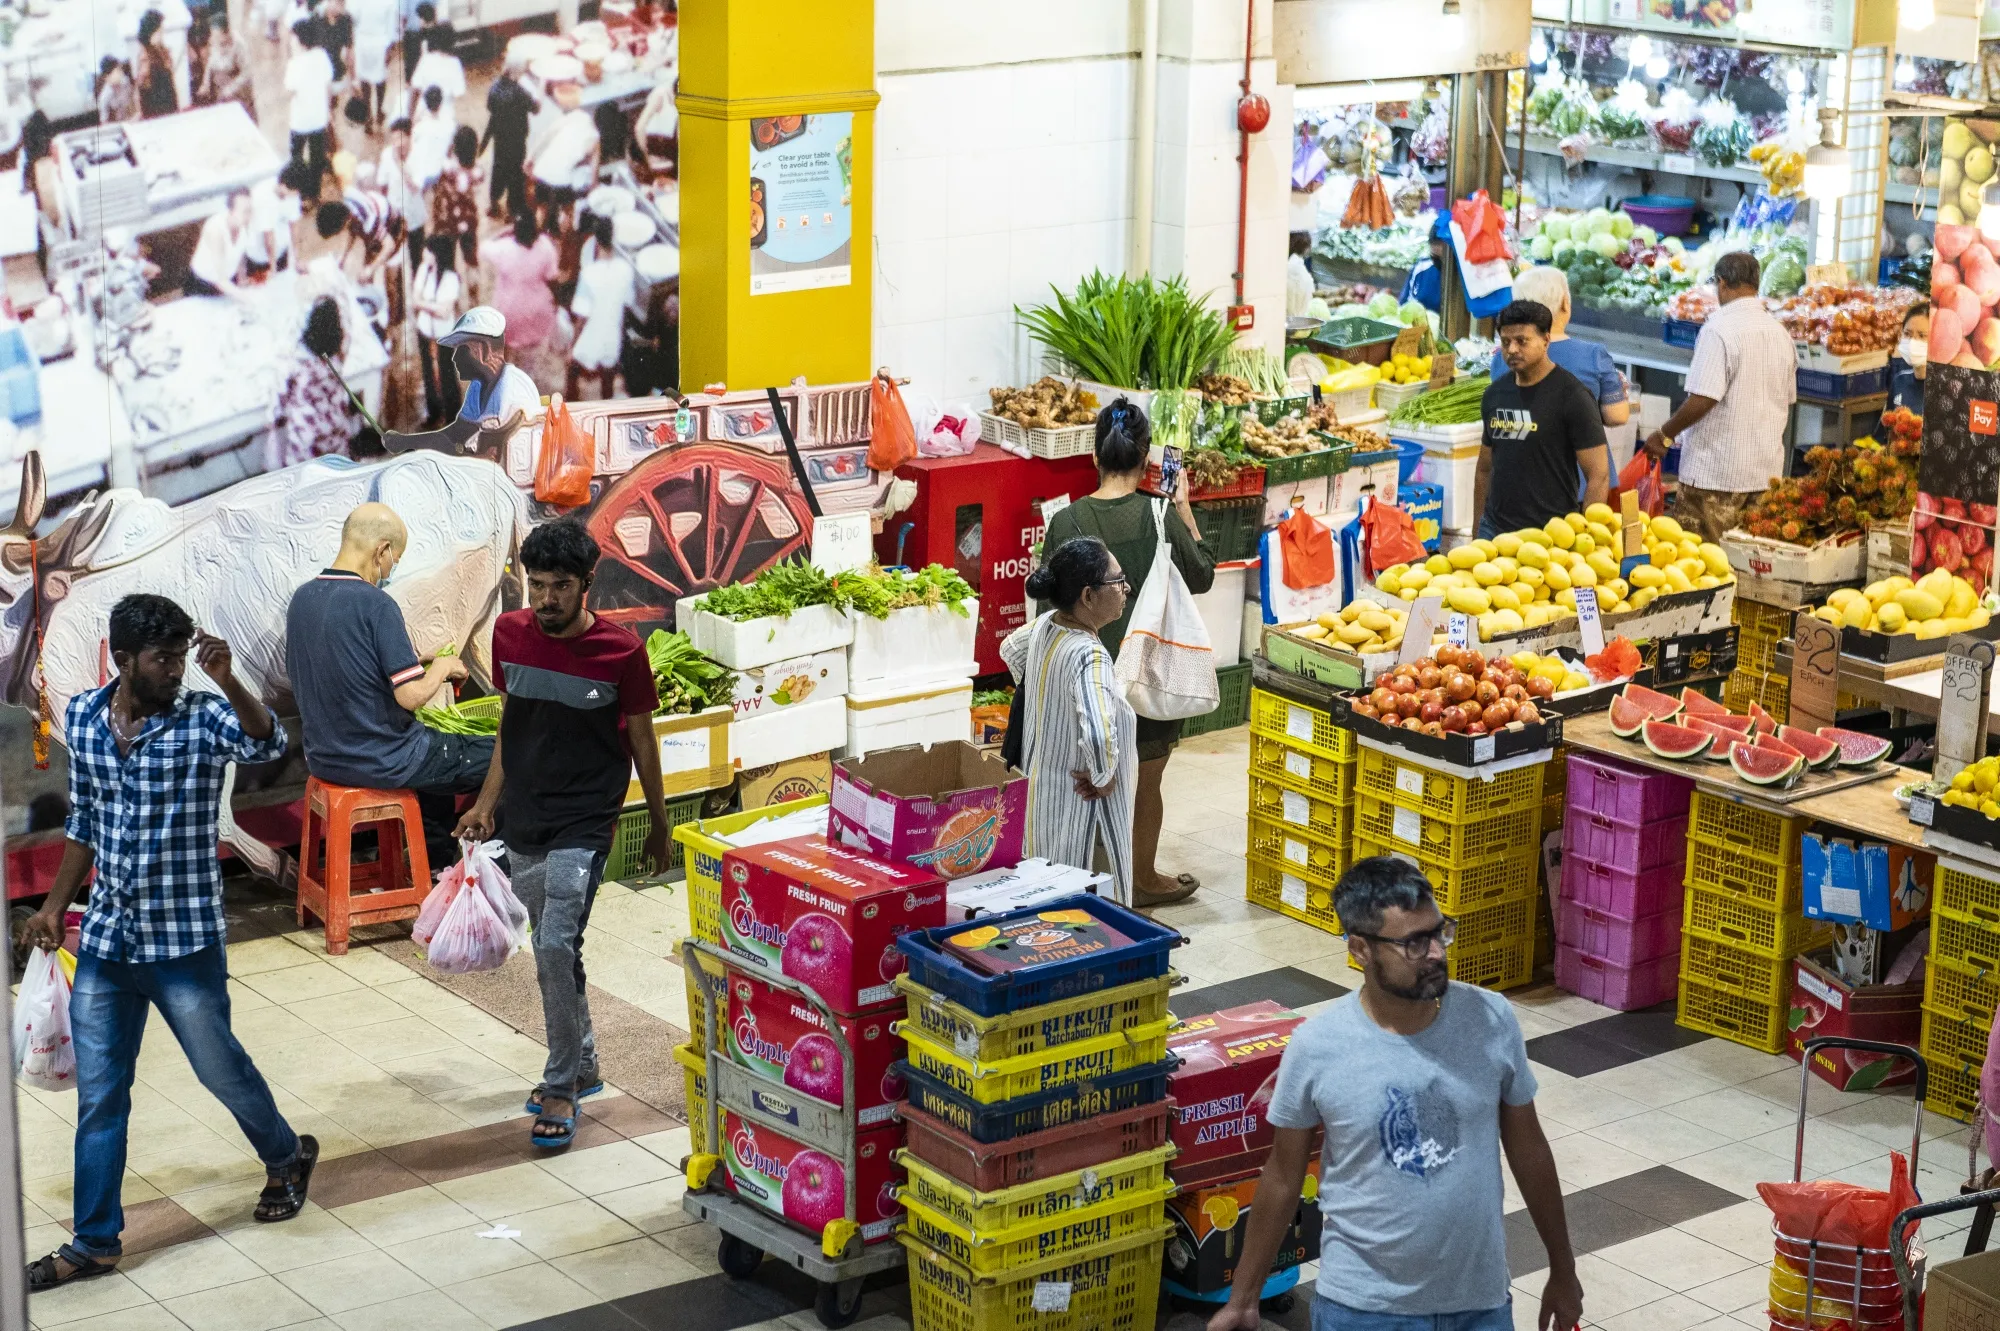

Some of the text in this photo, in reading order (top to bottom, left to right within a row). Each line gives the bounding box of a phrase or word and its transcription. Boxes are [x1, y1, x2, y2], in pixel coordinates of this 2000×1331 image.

[789, 161, 808, 169] avoid
[1974, 412, 1992, 428] Pay
[1021, 526, 1046, 547] FIR
[1000, 602, 1026, 614] OPERATI
[1946, 656, 1980, 676] OFFER
[1800, 669, 1825, 688] EACH
[906, 827, 927, 836] CITRUS
[763, 850, 867, 888] FRESH FRUIT
[805, 842, 909, 878] FRESH FRUIT
[787, 884, 847, 917] FRESH FRUIT
[738, 911, 788, 948] Apple
[1003, 923, 1055, 938] CITRUS
[1020, 940, 1105, 964] PREMIUM
[790, 1004, 819, 1026] FRESH
[1063, 1005, 1114, 1029] FRUIT
[1045, 1019, 1112, 1047] Ratchaburi/TH
[742, 1029, 790, 1065] Apple
[1064, 1049, 1114, 1074] FRUIT
[1180, 1093, 1245, 1125] FRESH
[1195, 1114, 1257, 1145] APPLE
[741, 1142, 788, 1180] Apple
[1061, 1215, 1111, 1243] FRUIT
[1061, 1254, 1115, 1282] FRUIT
[1070, 1273, 1108, 1295] buri/TH
